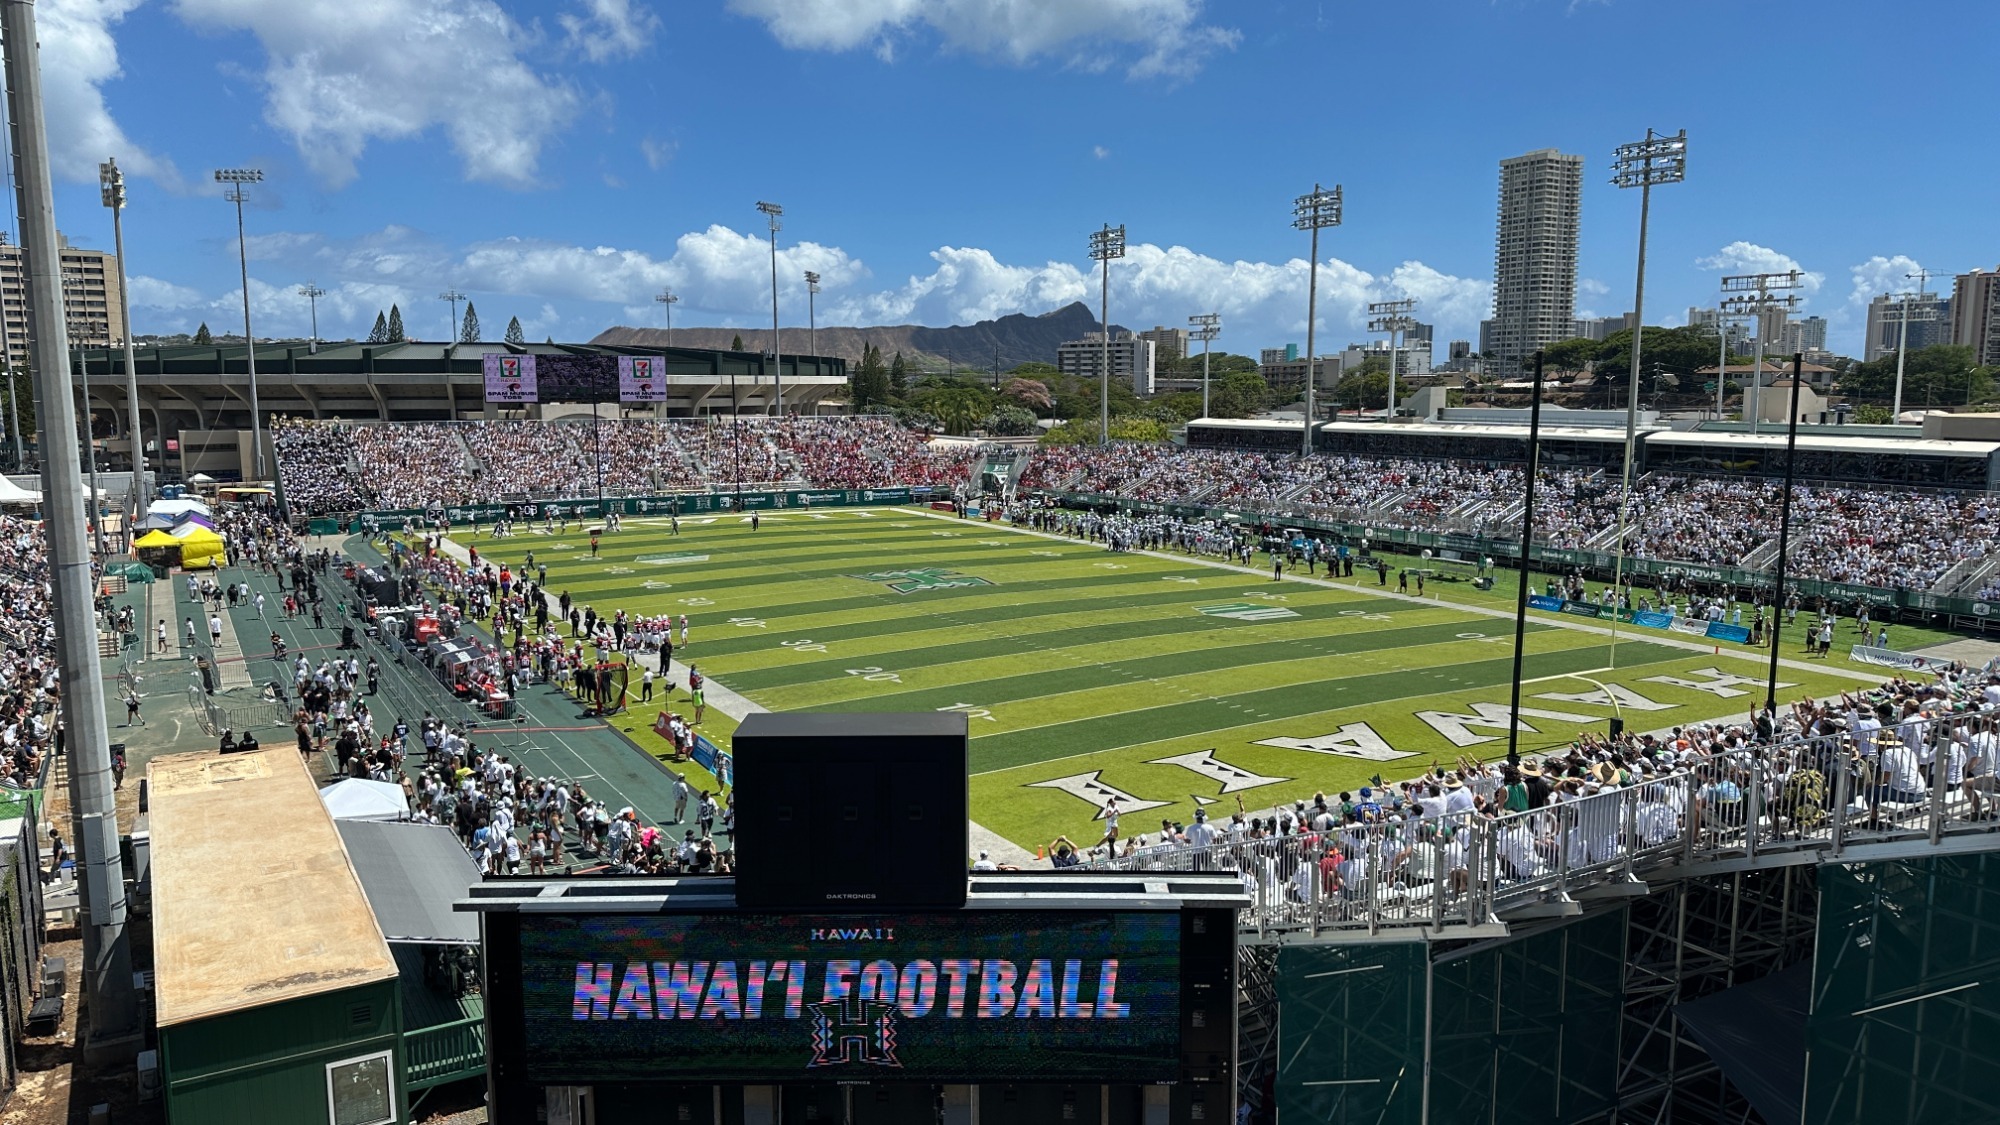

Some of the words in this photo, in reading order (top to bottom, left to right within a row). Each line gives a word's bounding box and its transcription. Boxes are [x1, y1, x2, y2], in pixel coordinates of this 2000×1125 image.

[1492, 543, 1519, 551] HAWAIIAN
[781, 639, 827, 652] 30
[1874, 654, 1911, 665] HAWAIIAN
[845, 666, 900, 682] 20
[823, 958, 1131, 1018] FOOTBALL
